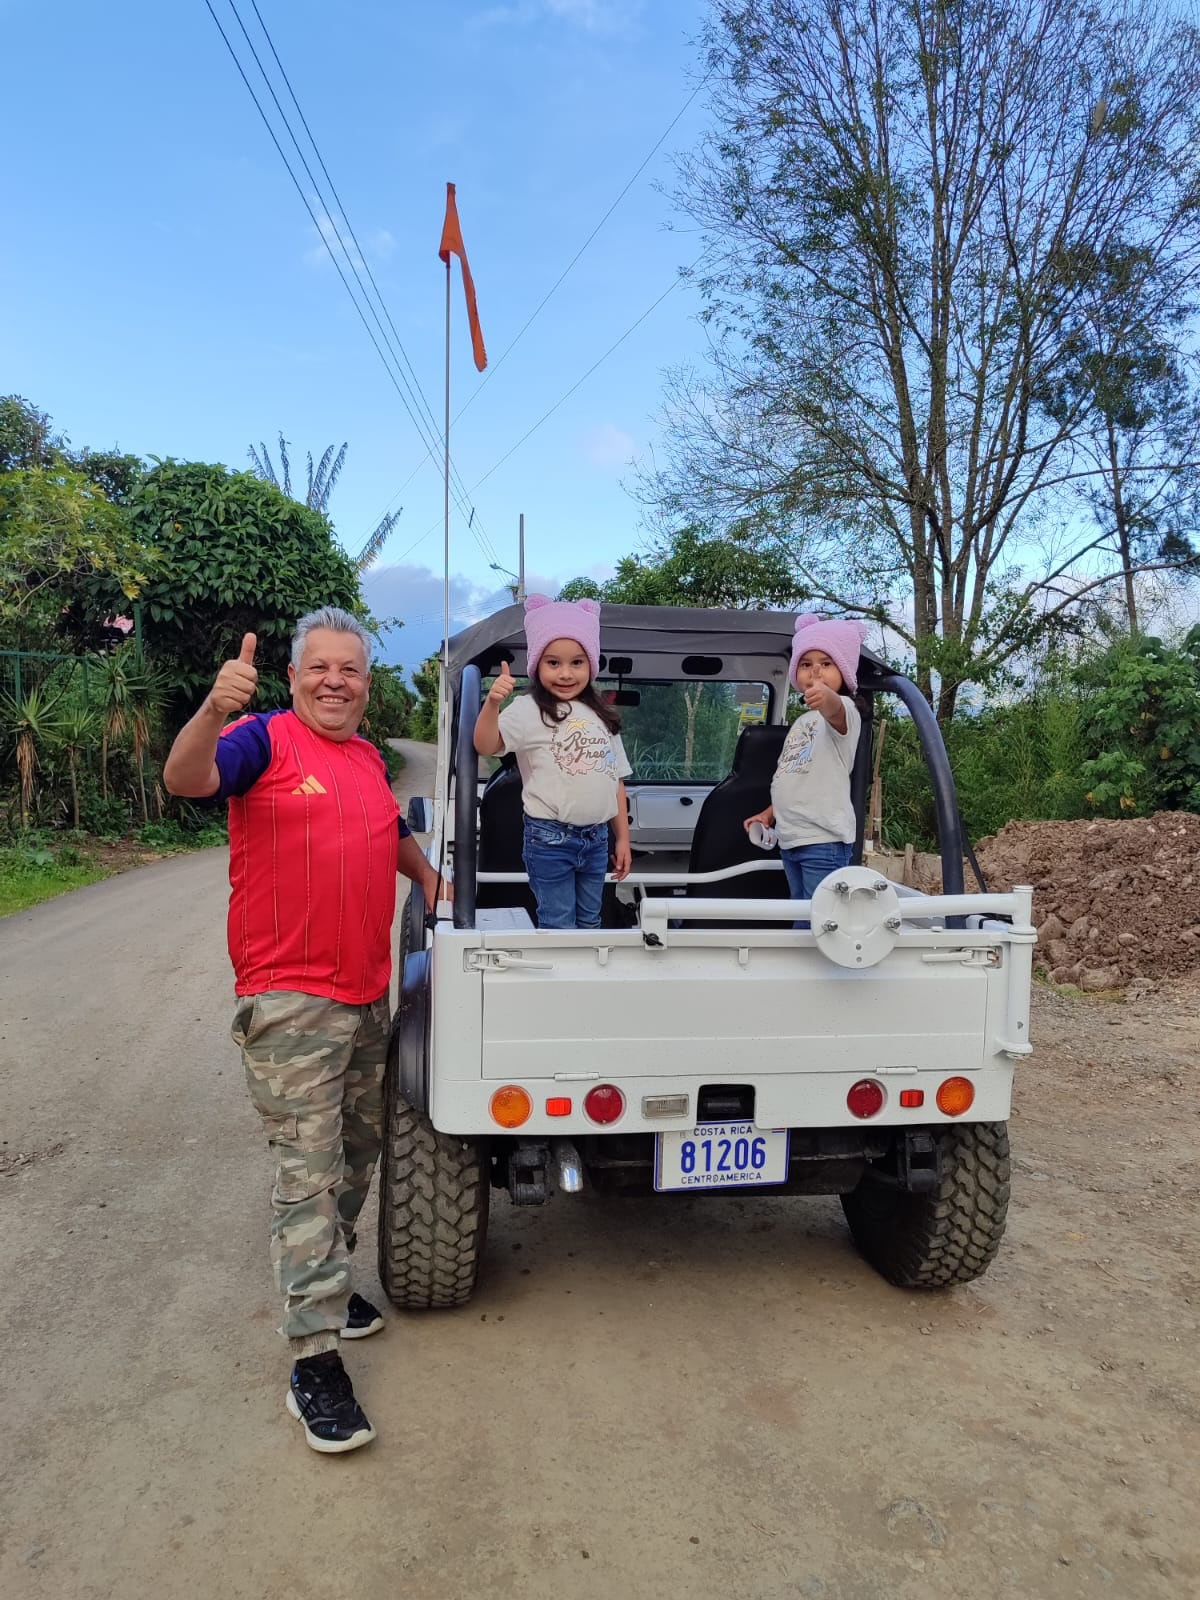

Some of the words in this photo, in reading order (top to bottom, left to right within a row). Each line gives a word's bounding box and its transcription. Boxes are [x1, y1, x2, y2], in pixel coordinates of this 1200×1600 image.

[563, 731, 608, 751] Roam
[574, 745, 606, 763] Free
[693, 1127, 726, 1137] COSTA
[730, 1125, 753, 1135] RICA
[680, 1137, 766, 1174] 81206
[681, 1172, 762, 1185] CENTROAMERICA
